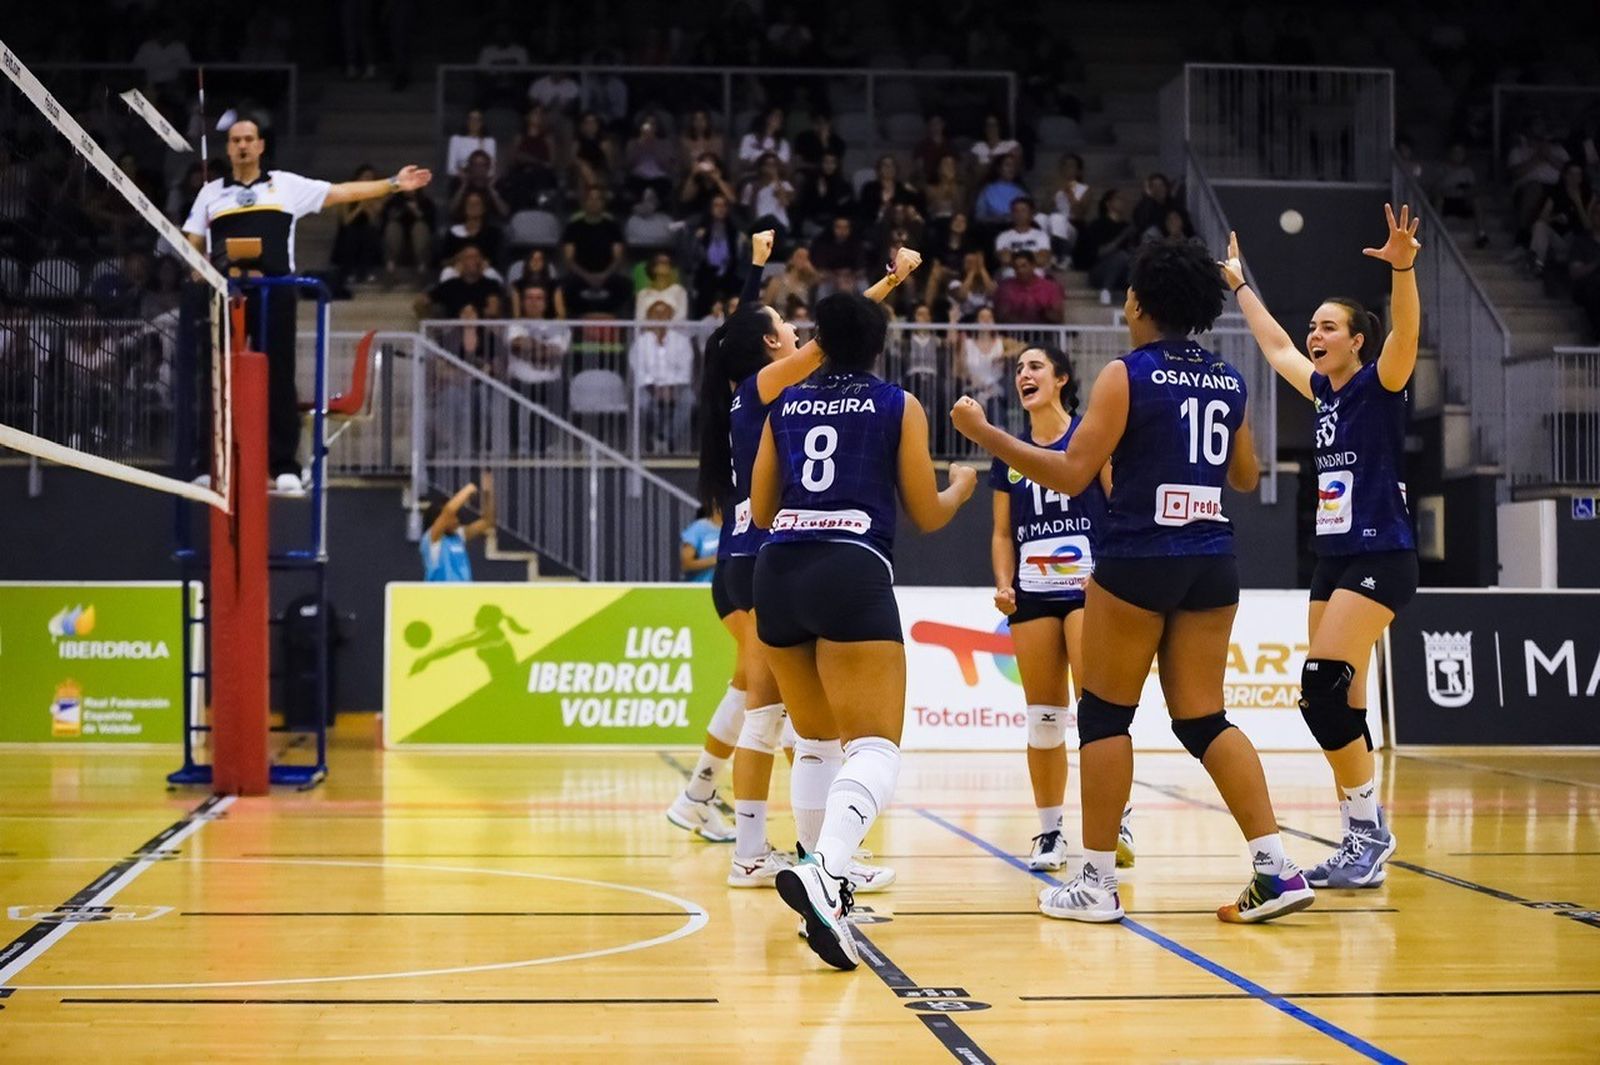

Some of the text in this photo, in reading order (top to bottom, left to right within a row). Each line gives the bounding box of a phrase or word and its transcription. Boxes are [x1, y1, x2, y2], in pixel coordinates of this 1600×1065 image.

[1151, 369, 1240, 393] OSAYANDE
[781, 398, 876, 416] MOREIRA
[1180, 397, 1231, 466] 16
[801, 425, 838, 492] 8
[1193, 500, 1220, 516] redp
[1030, 517, 1091, 537] MADRID
[59, 640, 169, 659] IBERDROLA
[625, 627, 692, 658] LIGA
[528, 663, 693, 692] IBERDROLA
[1524, 640, 1600, 696] M
[561, 699, 689, 727] VOLEIBOL
